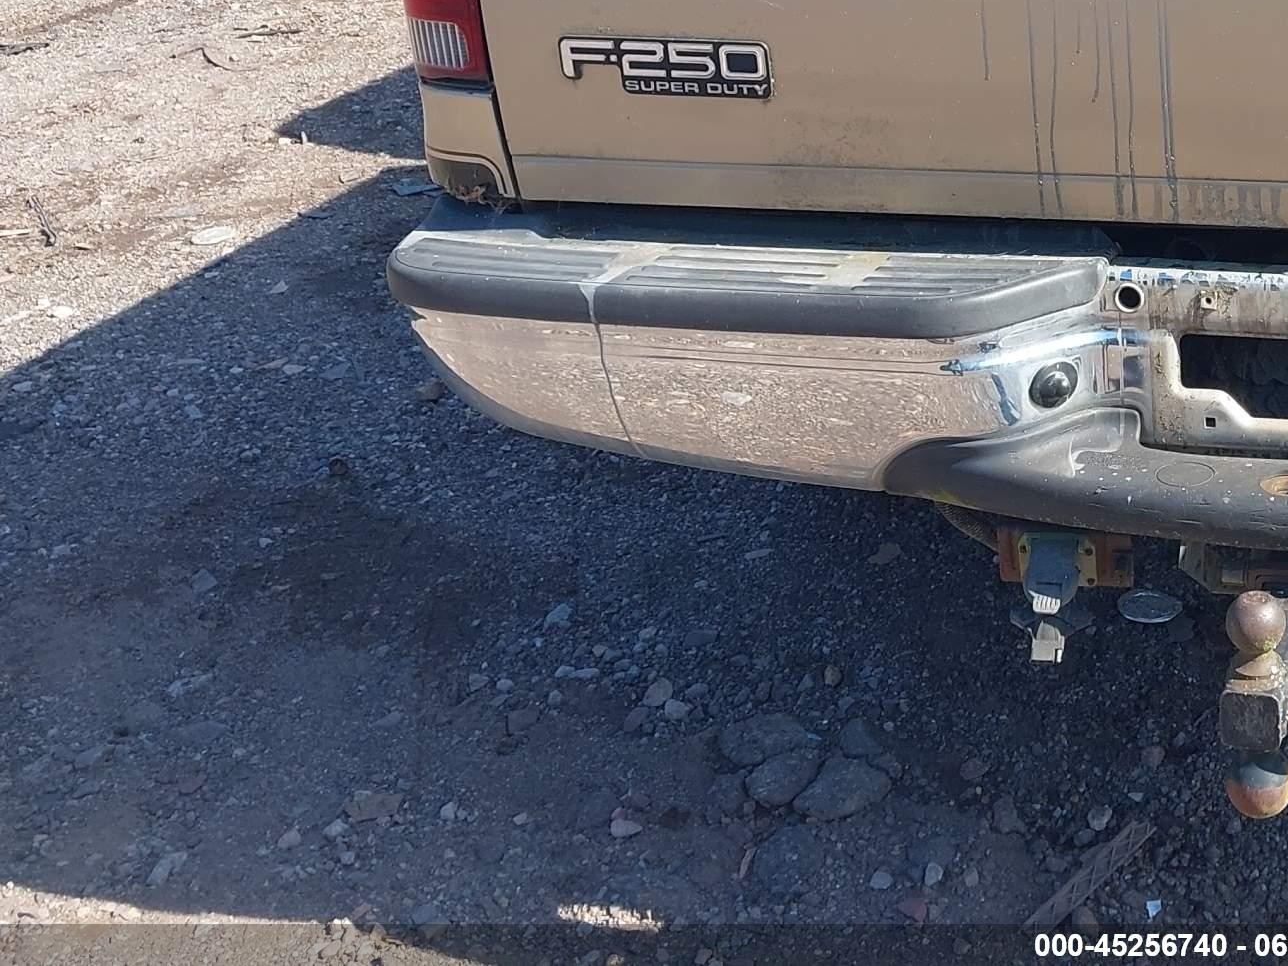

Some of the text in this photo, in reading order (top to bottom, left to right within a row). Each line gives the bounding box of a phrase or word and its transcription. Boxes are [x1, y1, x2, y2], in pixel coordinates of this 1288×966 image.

[559, 38, 768, 81] F-250
[625, 79, 769, 96] SUPER DUTY
